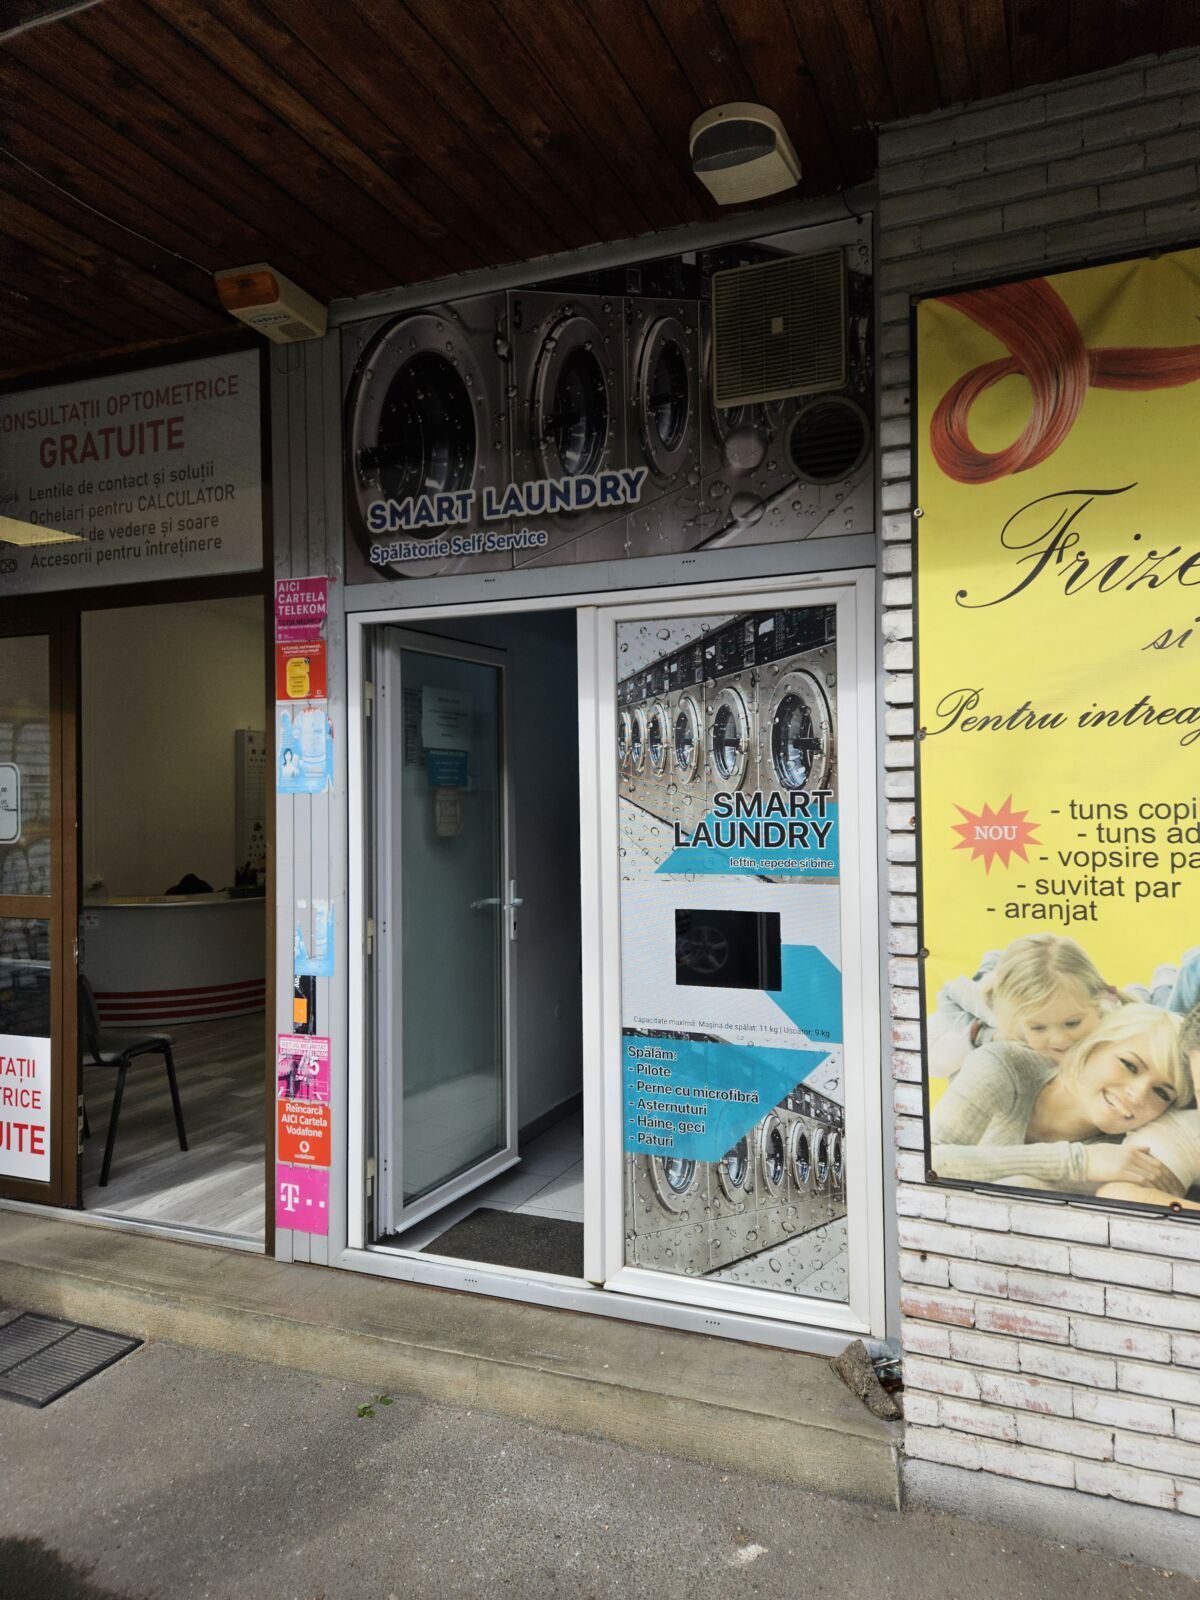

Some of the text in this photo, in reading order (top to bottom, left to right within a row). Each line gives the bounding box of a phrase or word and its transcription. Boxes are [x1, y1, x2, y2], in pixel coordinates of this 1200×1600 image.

[0, 375, 240, 433] ONSULTAȚII OPTOMETRICE
[39, 416, 185, 469] GRATUITE
[29, 461, 214, 502] Lentile de contact și soluții
[30, 484, 235, 525] Ochelari pentru CALCULATOR
[368, 468, 647, 531] SMART LAUNDRY
[88, 526, 105, 542] de
[109, 520, 156, 540] vedere
[161, 517, 173, 537] și
[178, 514, 219, 532] soare
[30, 536, 222, 569] Accesorii pentru întreținere
[370, 529, 547, 564] Spălătorie Self Service
[278, 592, 325, 605] CARTELA
[279, 582, 300, 593] AICI
[279, 603, 326, 616] TELEKOM
[1140, 616, 1200, 651] si
[922, 687, 1068, 736] Pentru
[712, 790, 833, 820] SMART
[1069, 799, 1128, 820] tuns
[1138, 797, 1197, 825] copi
[674, 820, 833, 849] LAUNDRY
[974, 825, 1018, 841] NOU
[1096, 822, 1156, 844] tuns
[1167, 821, 1200, 844] ad
[760, 858, 797, 870] repede
[810, 858, 834, 869] bine
[1058, 846, 1159, 872] vopsire
[1171, 851, 1200, 874] pa
[1035, 875, 1125, 897] suvitat
[1135, 880, 1182, 903] par
[1005, 899, 1098, 926] aranjat
[633, 1016, 667, 1025] Capacitate
[725, 1022, 733, 1030] de
[759, 1024, 767, 1032] 11
[769, 1025, 778, 1034] kg
[815, 1028, 820, 1036] 9
[821, 1028, 830, 1038] kg
[628, 1046, 677, 1061] Spălăm:
[636, 1063, 672, 1077] Pilote
[0, 1087, 42, 1110] RICE
[636, 1081, 672, 1096] Perne
[675, 1086, 690, 1097] cu
[693, 1086, 760, 1104] microfibră
[281, 1113, 328, 1127] AICI Cartela
[637, 1098, 707, 1116] Așternuturi
[286, 1125, 323, 1138] Vodafone
[637, 1116, 676, 1131] Haine,
[678, 1119, 706, 1134] geci
[0, 1122, 45, 1156] ITE
[637, 1132, 674, 1148] Pături
